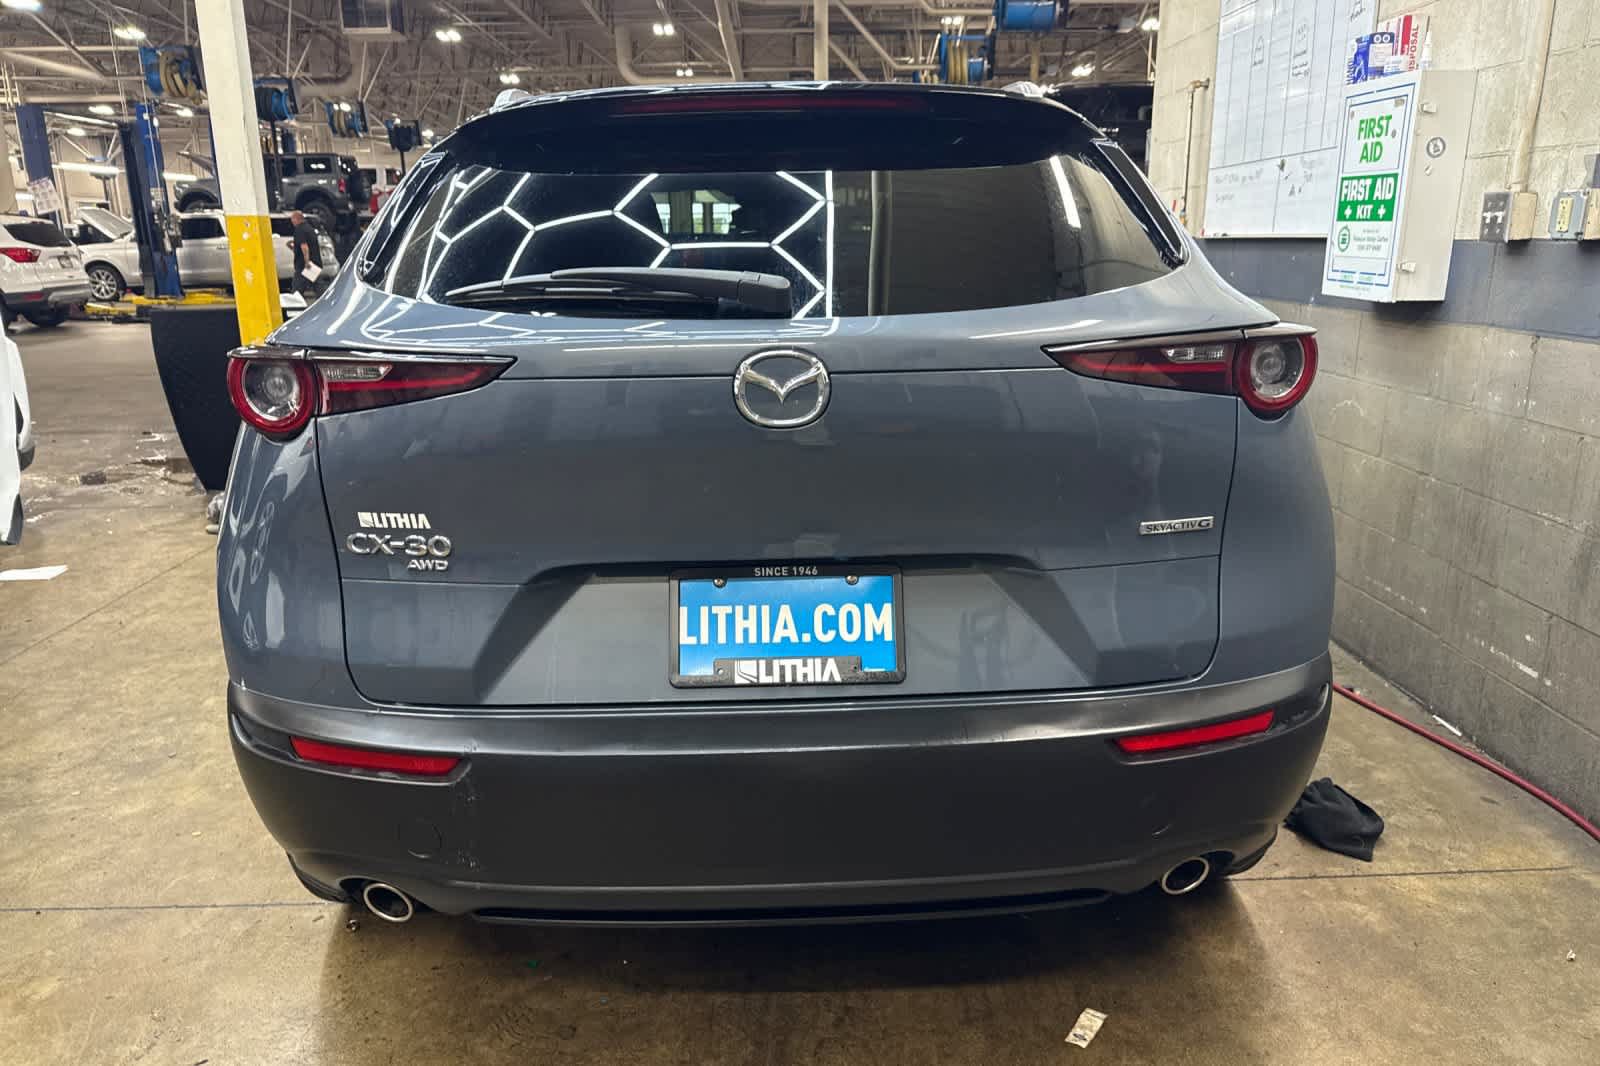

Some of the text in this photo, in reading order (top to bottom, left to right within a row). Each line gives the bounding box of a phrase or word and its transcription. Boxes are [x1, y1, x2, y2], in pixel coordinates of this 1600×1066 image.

[1408, 24, 1419, 72] ISPOSAL
[1358, 114, 1393, 140] FIRST
[1359, 141, 1383, 163] AID
[1340, 176, 1395, 202] FIRST AID
[1355, 204, 1374, 220] KIT
[372, 512, 432, 529] LITHIA
[346, 532, 452, 557] CX-30
[407, 559, 449, 571] AWD
[754, 566, 819, 577] SINCE 1946
[680, 603, 894, 645] LITHIA.COM
[757, 657, 842, 683] LITHIA
